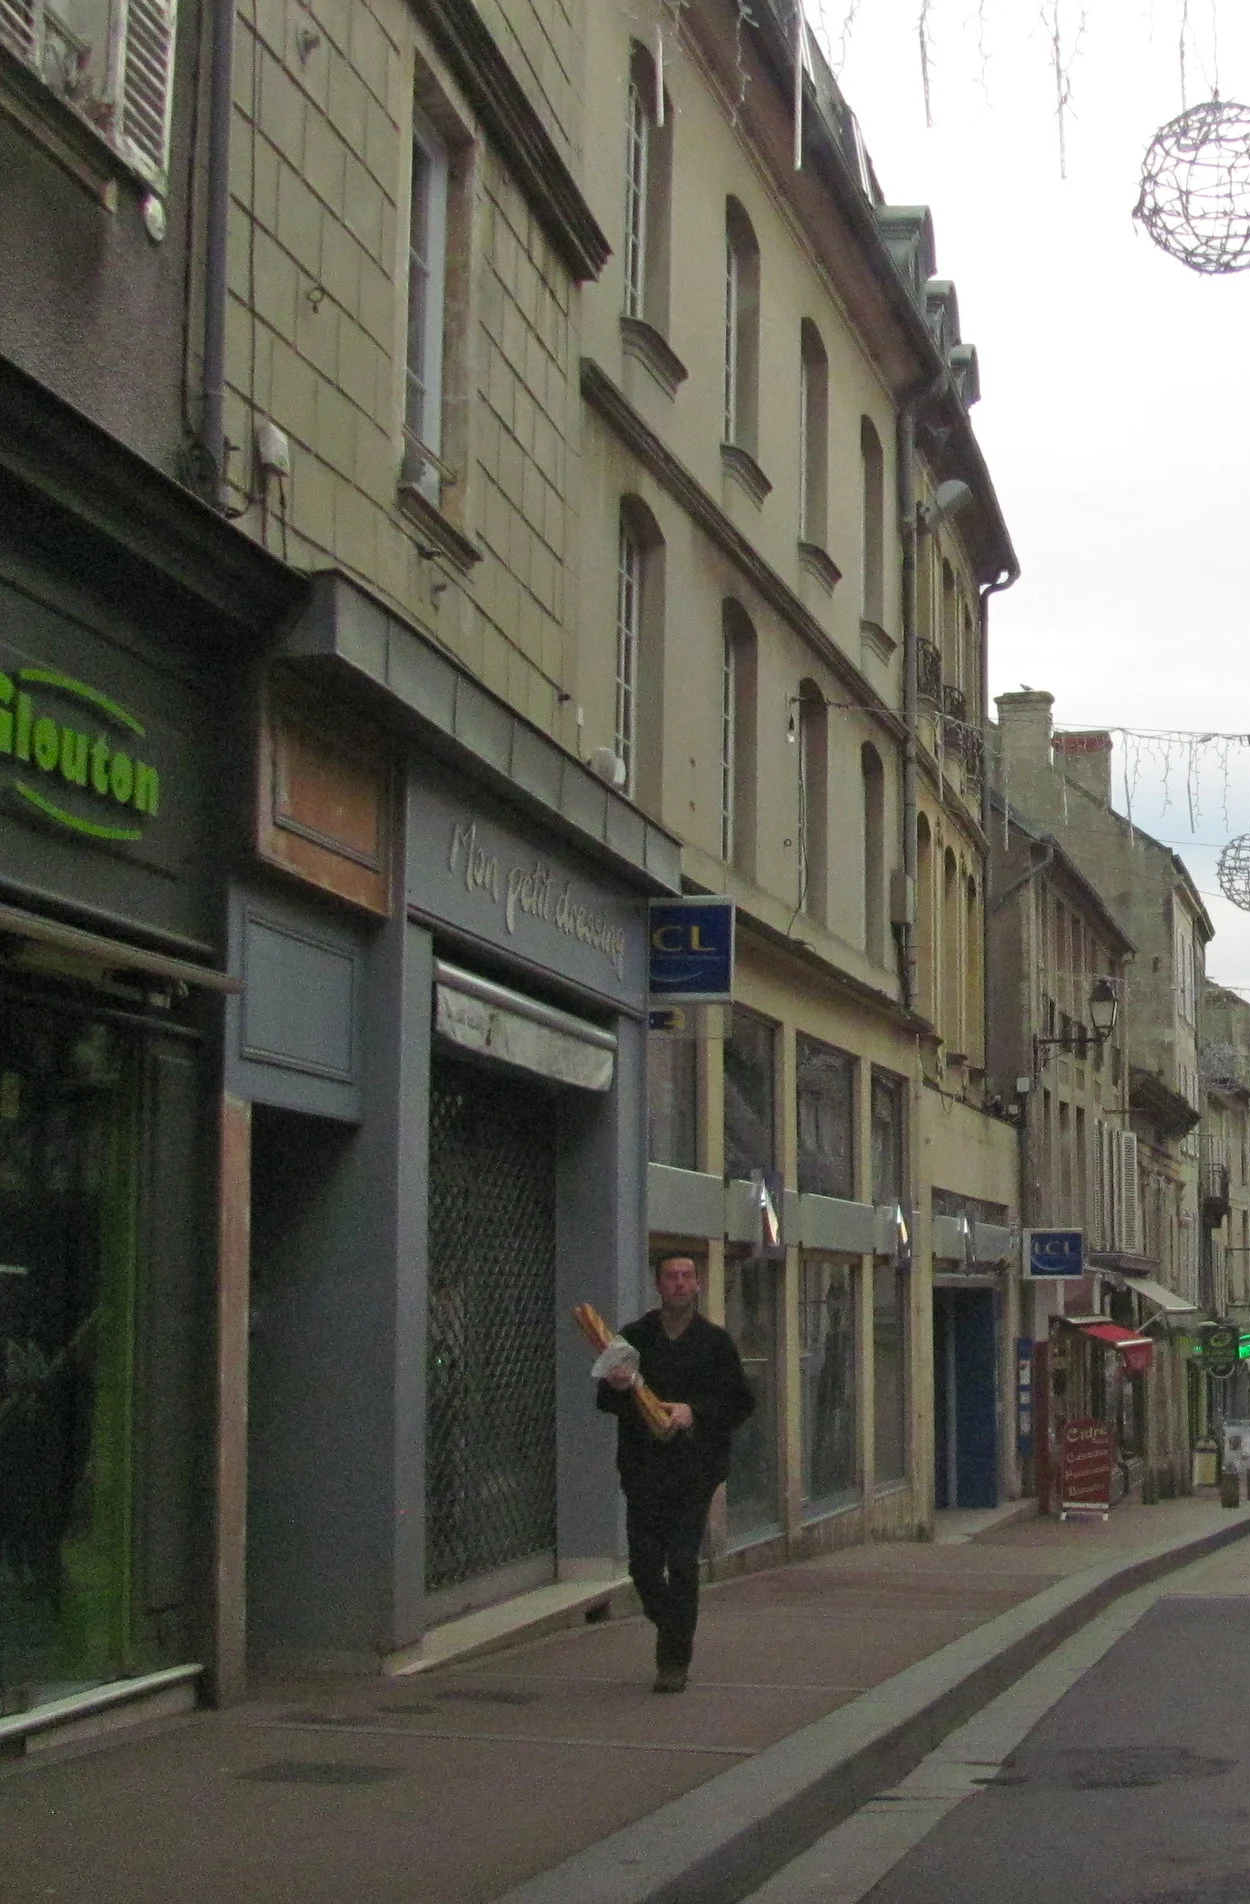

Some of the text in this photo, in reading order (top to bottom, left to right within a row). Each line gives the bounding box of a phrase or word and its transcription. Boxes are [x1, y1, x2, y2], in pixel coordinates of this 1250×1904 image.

[449, 822, 625, 981] Mon petit dressing
[1034, 1241, 1075, 1255] LCL
[1066, 1426, 1108, 1442] Cidre
